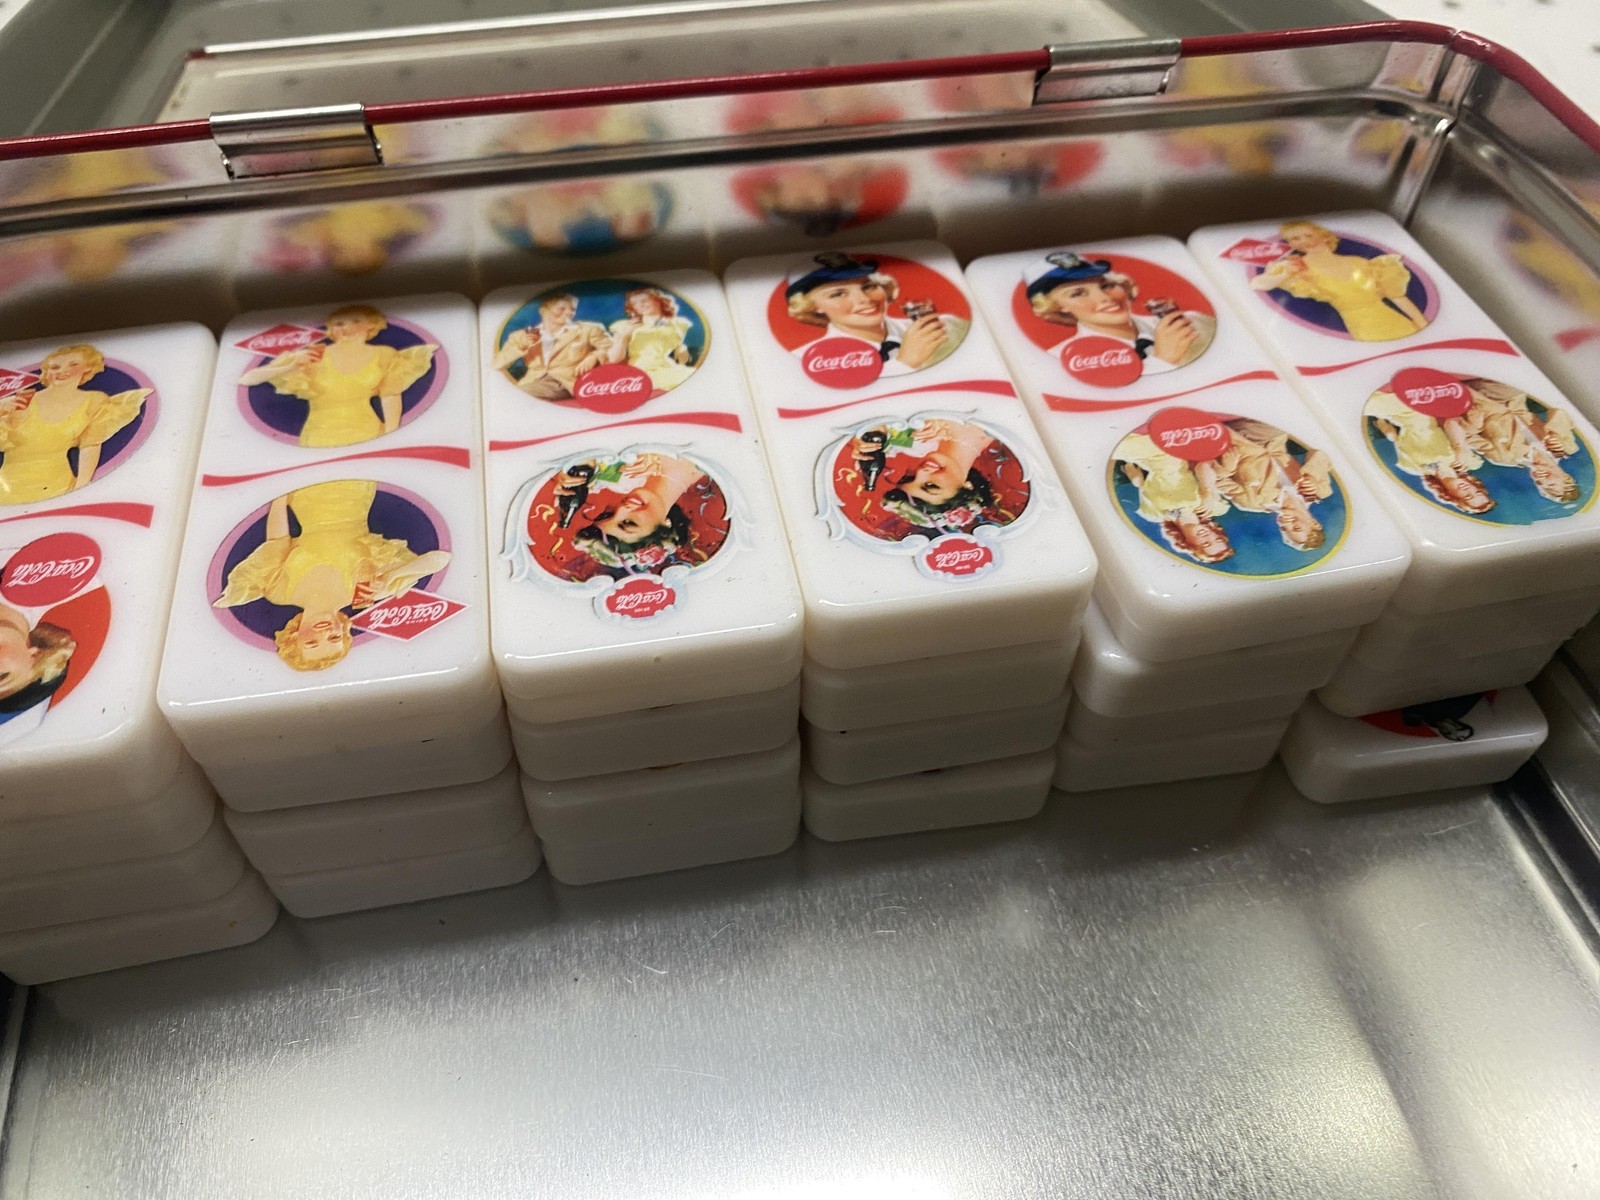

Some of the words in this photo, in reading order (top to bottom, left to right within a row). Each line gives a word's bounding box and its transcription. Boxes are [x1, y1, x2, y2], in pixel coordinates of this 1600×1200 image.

[807, 349, 875, 372] Coca-Cola
[1068, 348, 1132, 371] Coca-Cola
[578, 376, 644, 398] Coca-Cola
[1404, 382, 1463, 405] Coca-Cola
[1160, 423, 1222, 448] Coca-Cola
[934, 547, 984, 568] Coca-Cola
[5, 556, 95, 588] Coca-Cola
[615, 589, 668, 610] Coca-Cola
[368, 600, 448, 630] Coca-Cola
